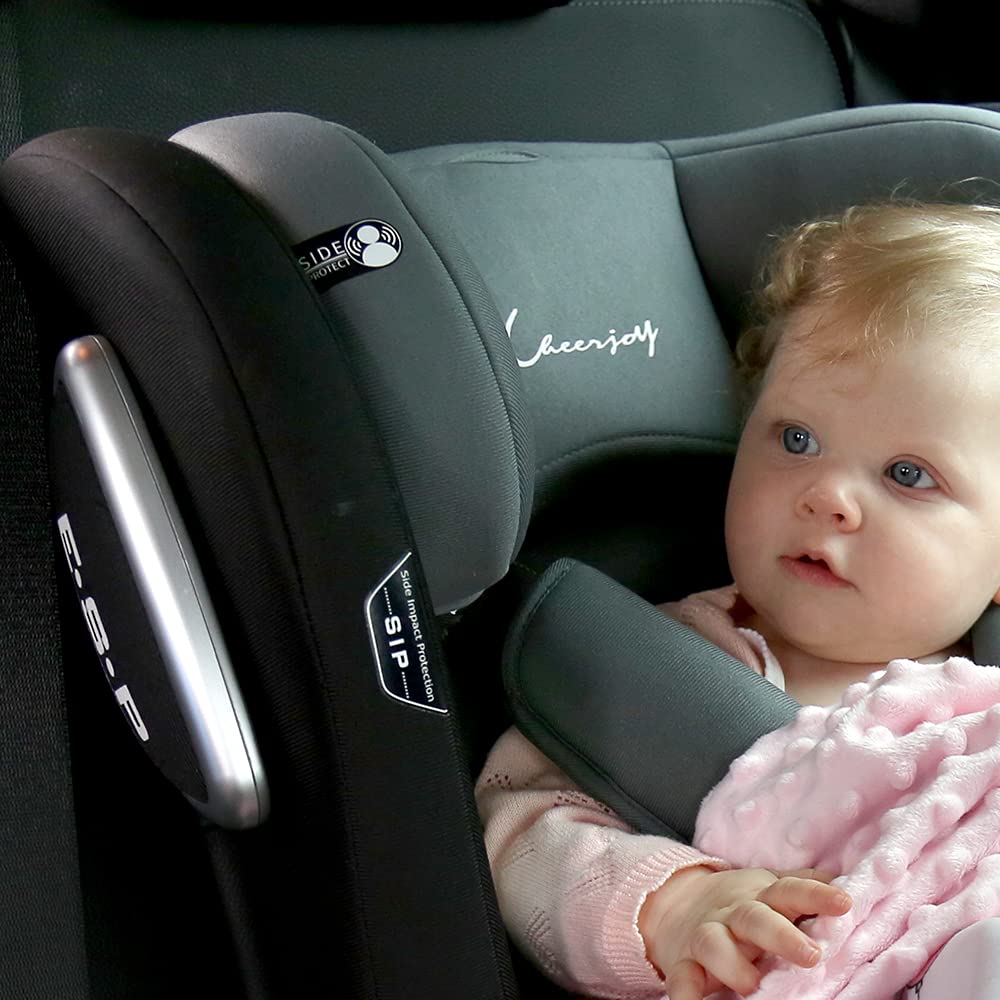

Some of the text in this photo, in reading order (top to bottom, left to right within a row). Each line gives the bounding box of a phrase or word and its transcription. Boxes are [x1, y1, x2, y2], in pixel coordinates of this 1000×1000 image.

[298, 240, 346, 271] SIDE
[384, 615, 409, 669] SIP
[400, 569, 435, 703] Side Impact Protection
